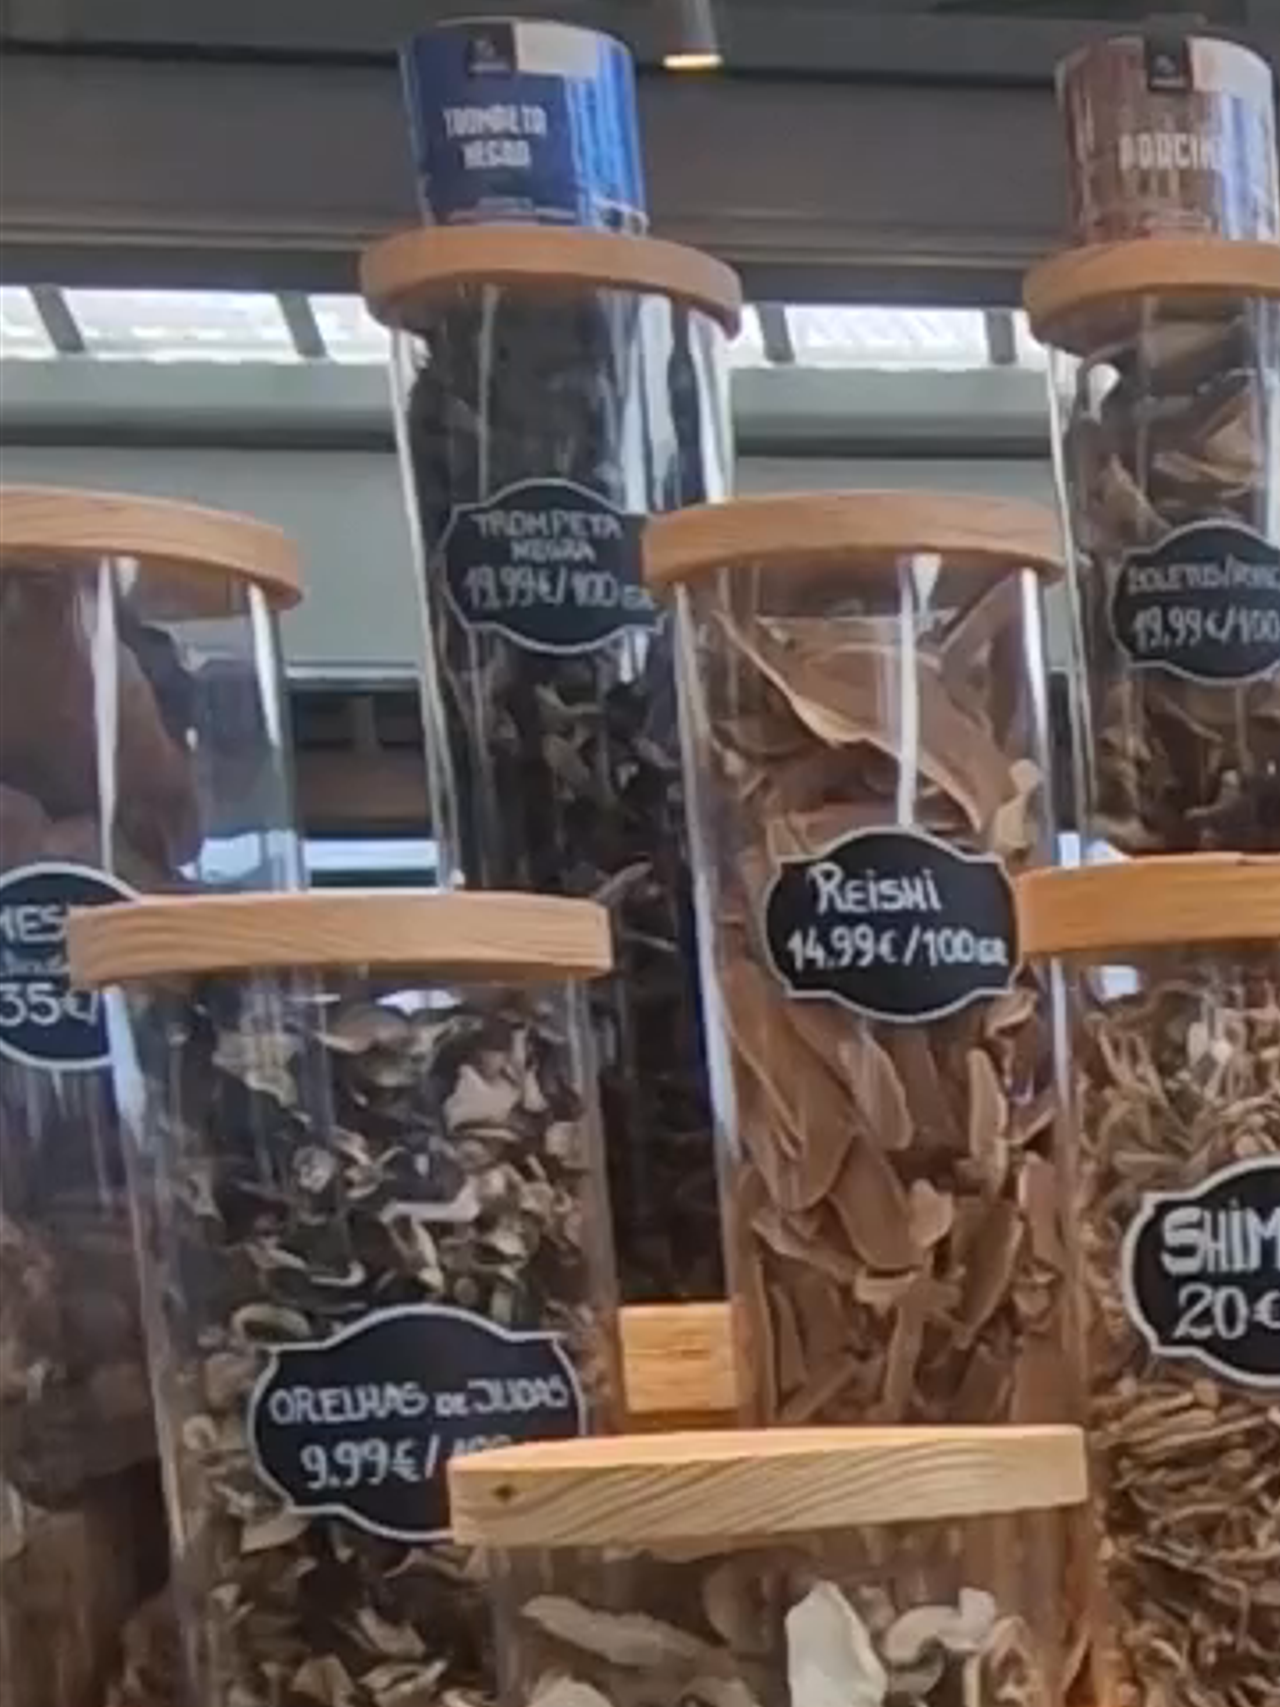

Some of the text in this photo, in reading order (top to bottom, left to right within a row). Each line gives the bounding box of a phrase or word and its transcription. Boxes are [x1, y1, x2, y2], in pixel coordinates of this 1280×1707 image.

[1117, 131, 1224, 171] PORCIN
[268, 1380, 429, 1426] ORELHAS
[468, 1374, 570, 1413] JUDAS
